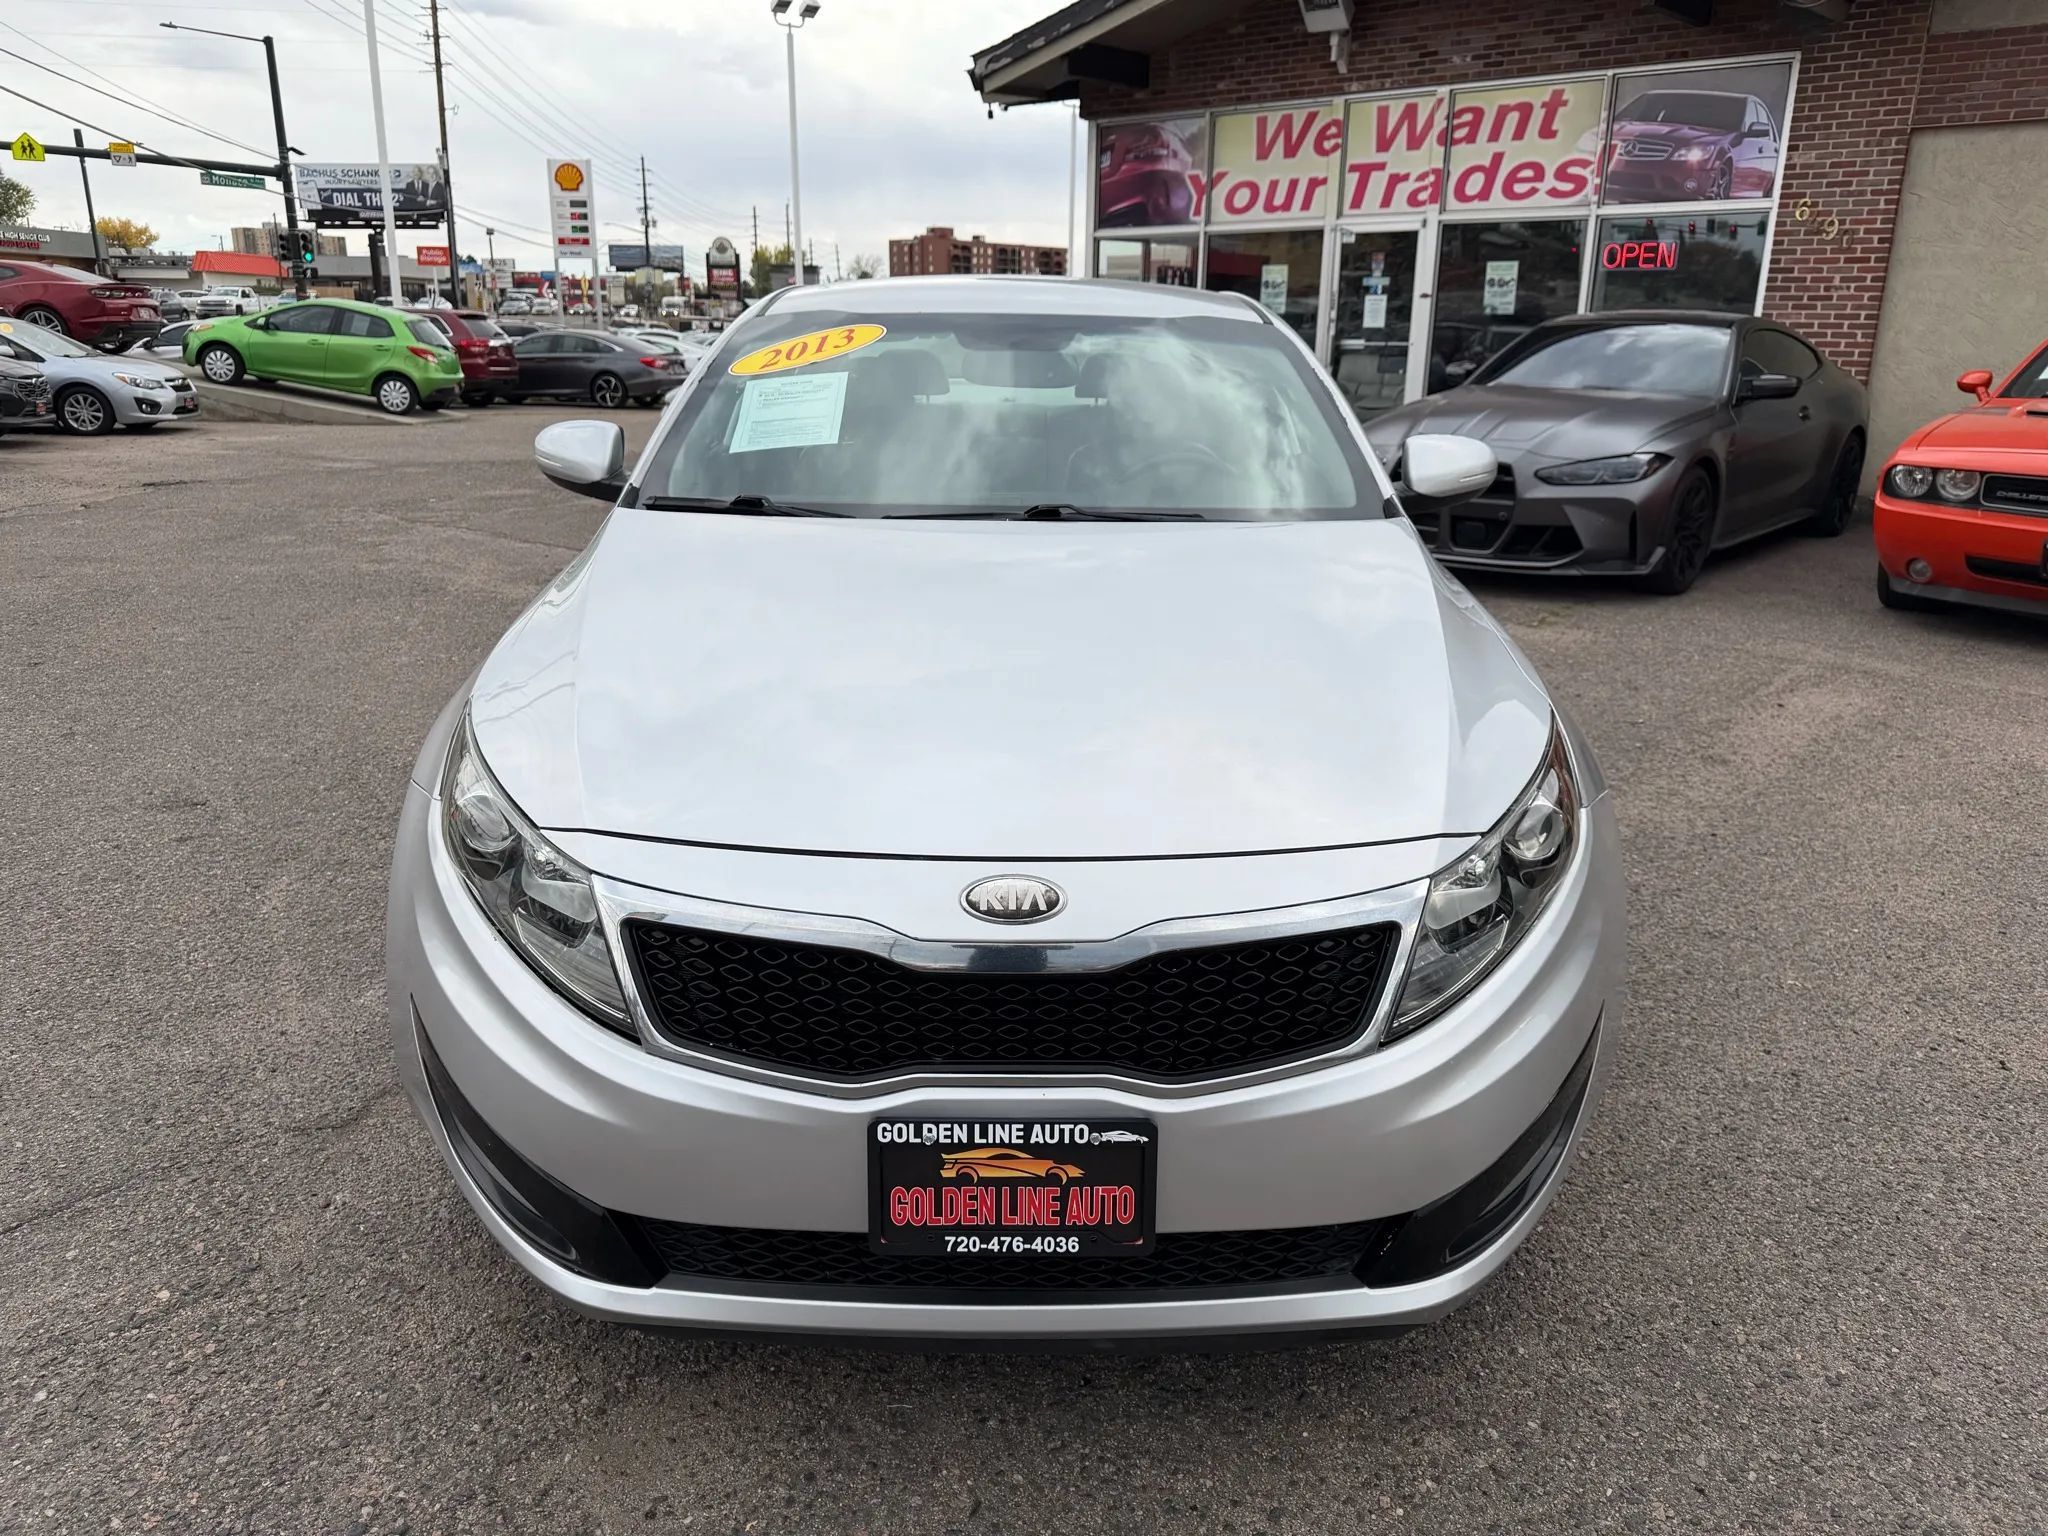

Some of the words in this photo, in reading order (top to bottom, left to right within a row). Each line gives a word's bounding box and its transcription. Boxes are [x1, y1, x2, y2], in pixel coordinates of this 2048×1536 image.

[1255, 110, 1344, 161] We
[1375, 88, 1569, 153] Want
[299, 167, 338, 178] BACHUS
[1187, 170, 1328, 218] Your
[1347, 143, 1619, 210] Trades!
[332, 191, 362, 207] DIAL
[363, 191, 385, 208] TH
[1602, 241, 1678, 270] OPEN
[759, 328, 856, 370] 2013
[979, 884, 1048, 911] KIA
[876, 1122, 968, 1145] GOLDEN
[974, 1123, 1024, 1144] LINE
[1029, 1123, 1090, 1145] AUTO
[889, 1185, 996, 1227] GOLDEN
[1001, 1185, 1061, 1226] LINE
[1065, 1184, 1136, 1226] AUTO
[944, 1235, 1080, 1253] 720-476-4036
